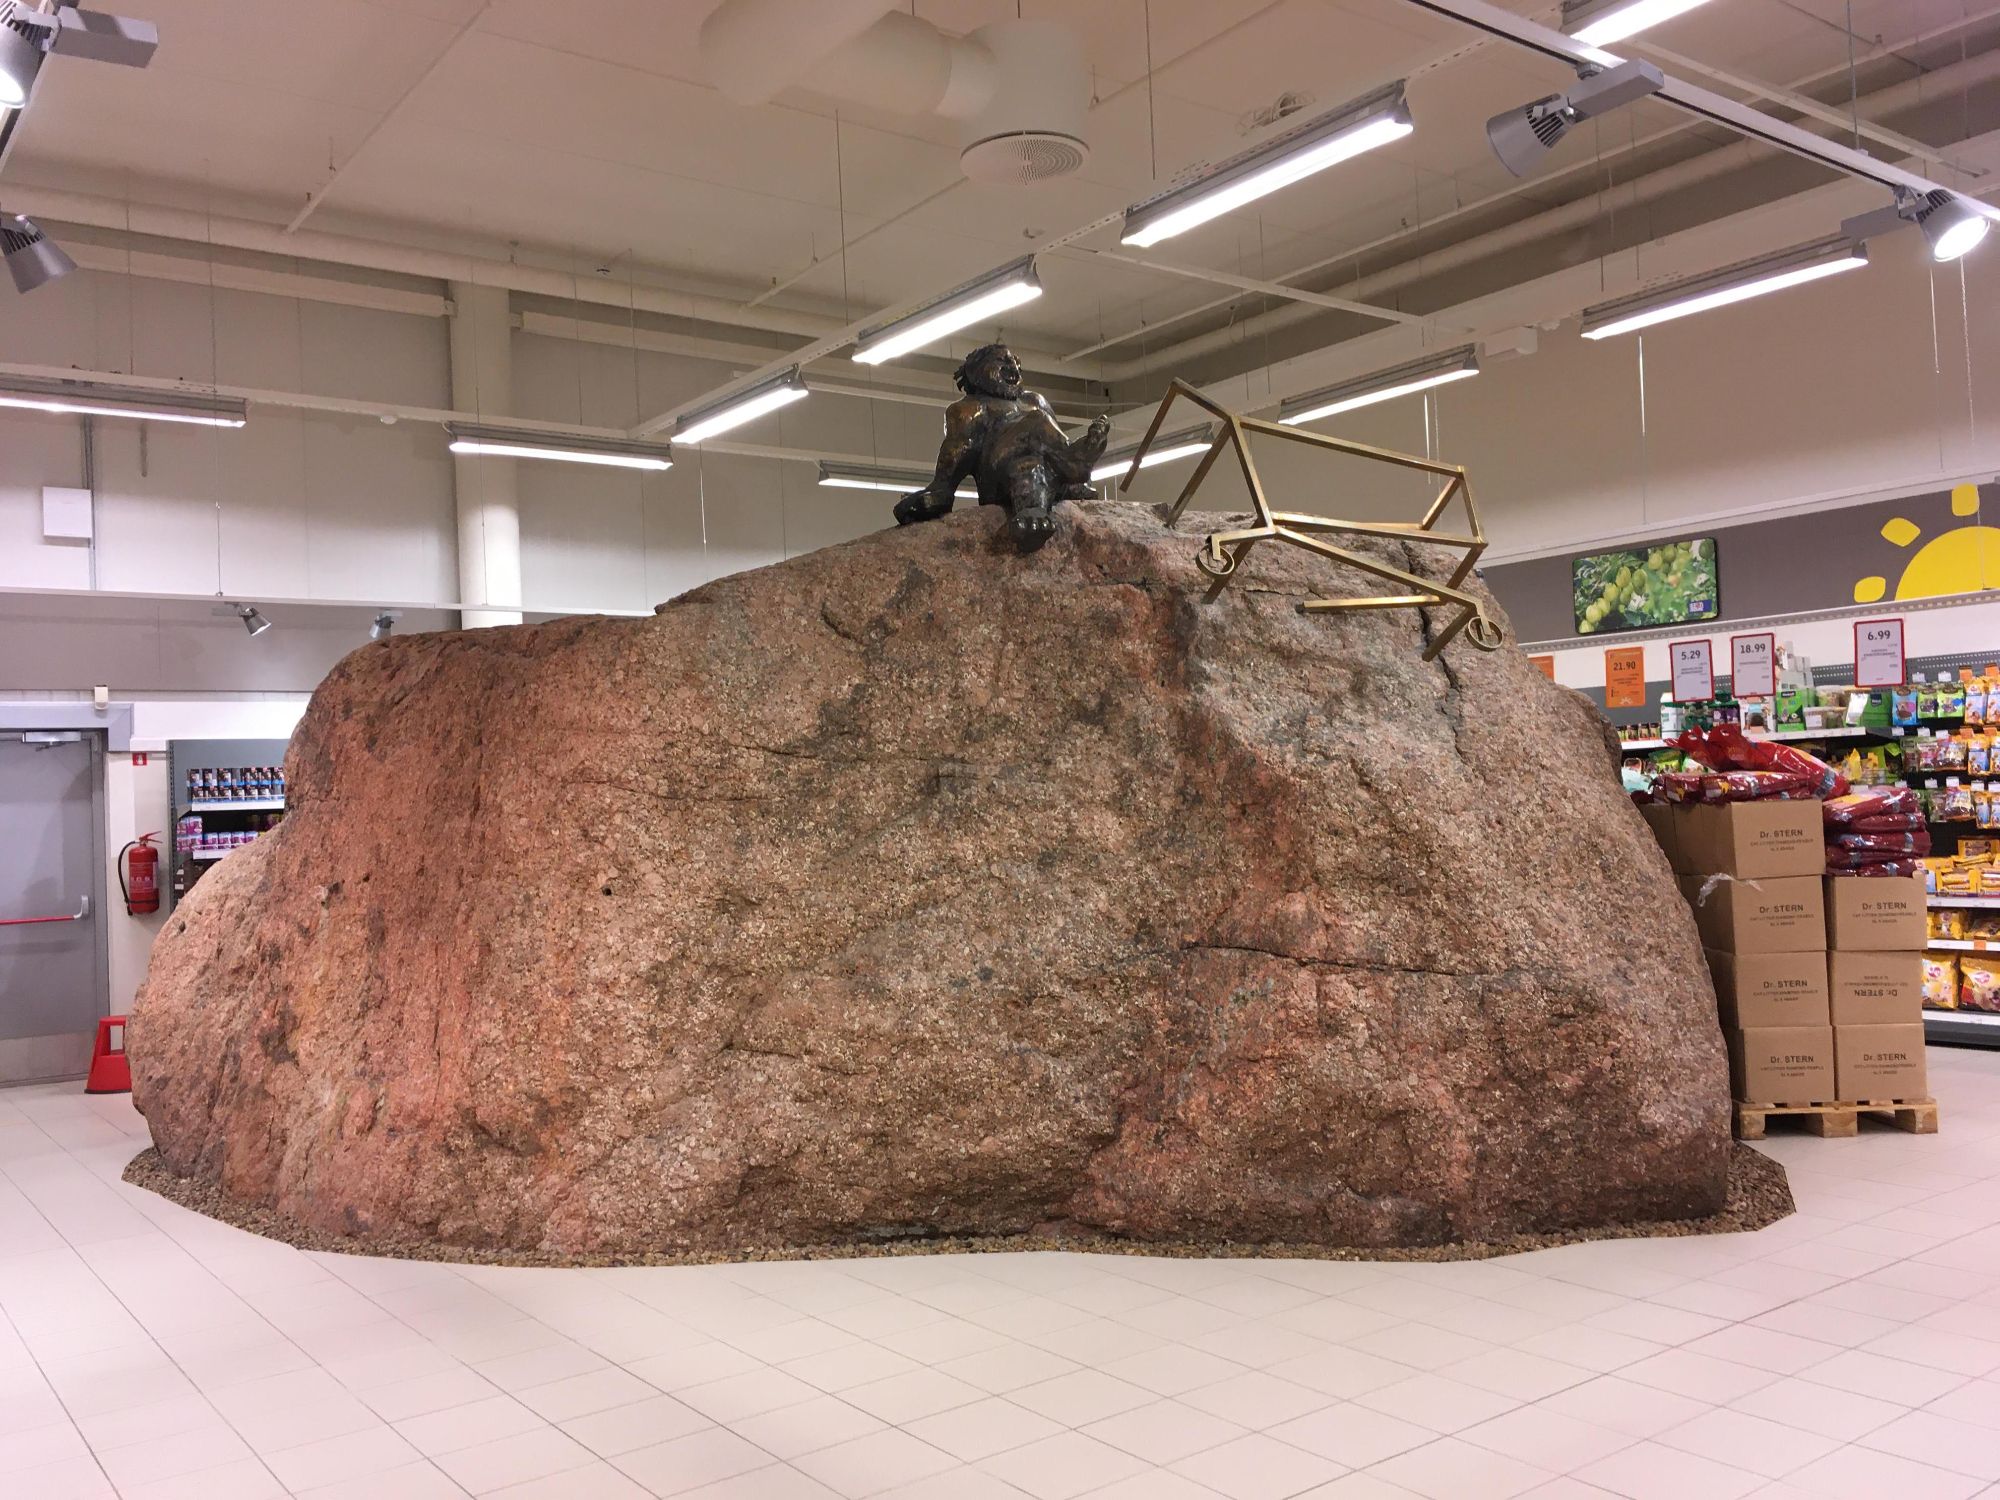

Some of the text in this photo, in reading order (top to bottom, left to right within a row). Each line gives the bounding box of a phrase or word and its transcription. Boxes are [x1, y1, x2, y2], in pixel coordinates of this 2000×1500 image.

[1868, 630, 1890, 641] 6.99
[1740, 643, 1766, 654] 18.99
[1681, 650, 1701, 660] 5.29
[1613, 661, 1636, 671] 21.90
[1759, 829, 1803, 838] Dr. STERN
[1774, 904, 1804, 913] STERN
[1876, 902, 1907, 910] STERN
[1777, 979, 1808, 988] STERN
[1854, 989, 1898, 997] Dr. STERN
[1770, 1055, 1815, 1064] Dr. STERN
[1863, 1053, 1907, 1061] Dr. STERN
